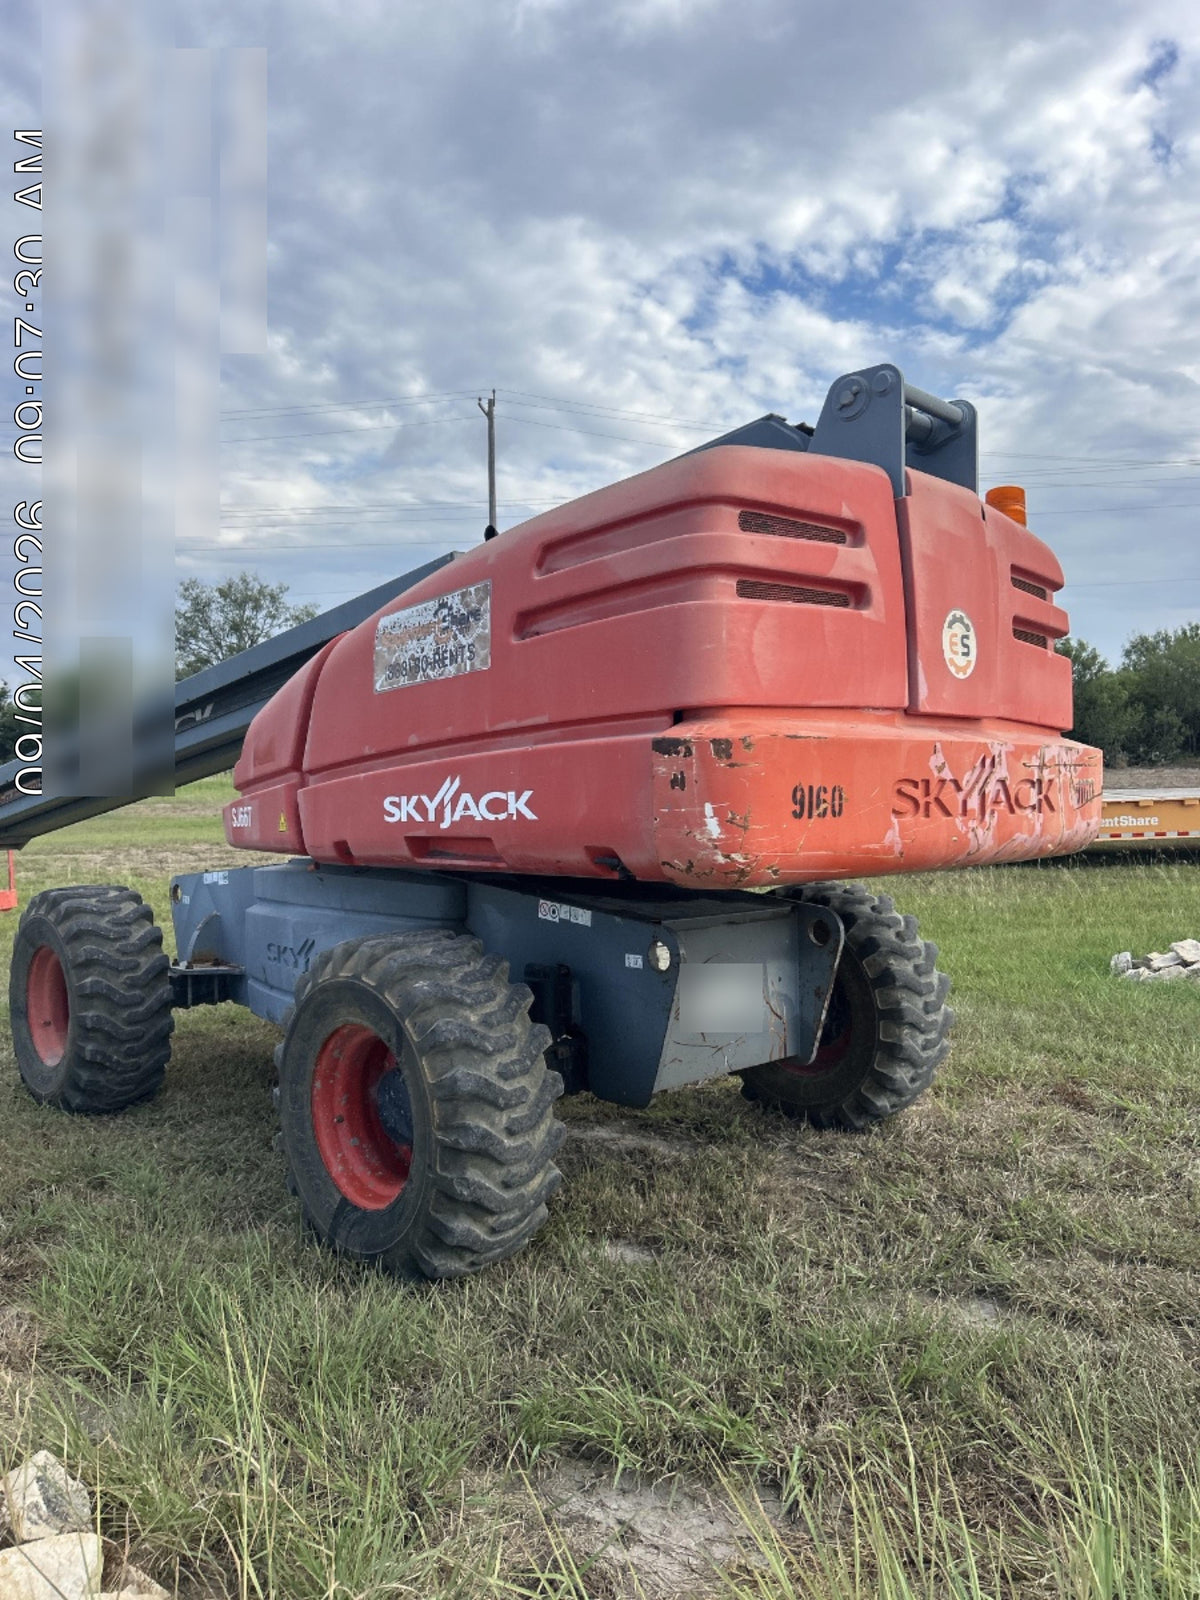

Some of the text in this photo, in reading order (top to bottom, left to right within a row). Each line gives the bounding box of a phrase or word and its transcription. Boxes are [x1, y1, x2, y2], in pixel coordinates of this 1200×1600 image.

[383, 775, 539, 829] SKYJACK
[791, 784, 844, 820] 9160
[892, 753, 1056, 825] SKYJACK
[1100, 815, 1159, 828] entShare
[266, 938, 316, 975] SKYJ
